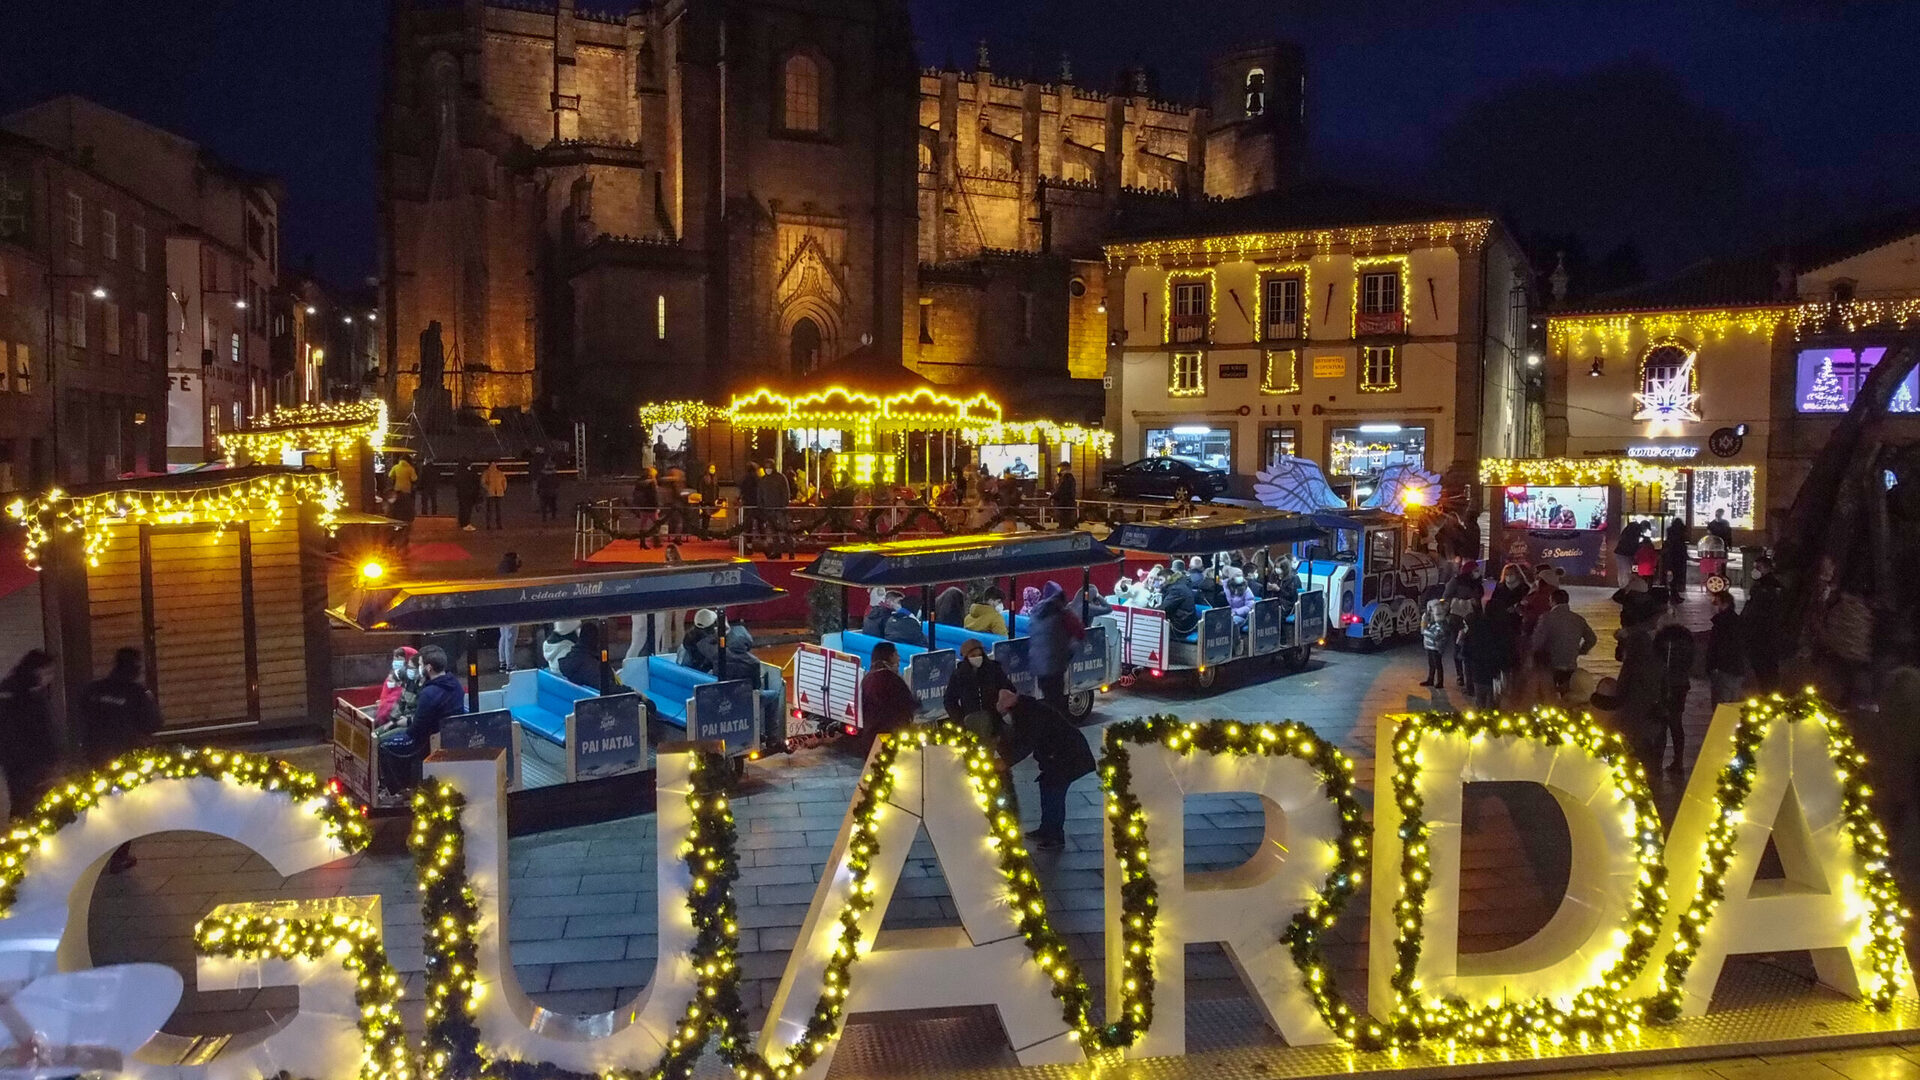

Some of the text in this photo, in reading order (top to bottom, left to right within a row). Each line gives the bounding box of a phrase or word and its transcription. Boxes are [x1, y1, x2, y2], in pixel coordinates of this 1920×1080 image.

[1239, 404, 1322, 416] OLIVA
[1553, 547, 1583, 558] Sentido
[531, 590, 568, 600] cidade
[573, 581, 604, 596] Natal
[1073, 658, 1103, 672] PAI NATAL
[916, 685, 948, 700] PAI NAT
[702, 717, 750, 737] PAI NATAL
[581, 733, 635, 755] PAI NATAL
[0, 688, 1916, 1080] GUARDA
